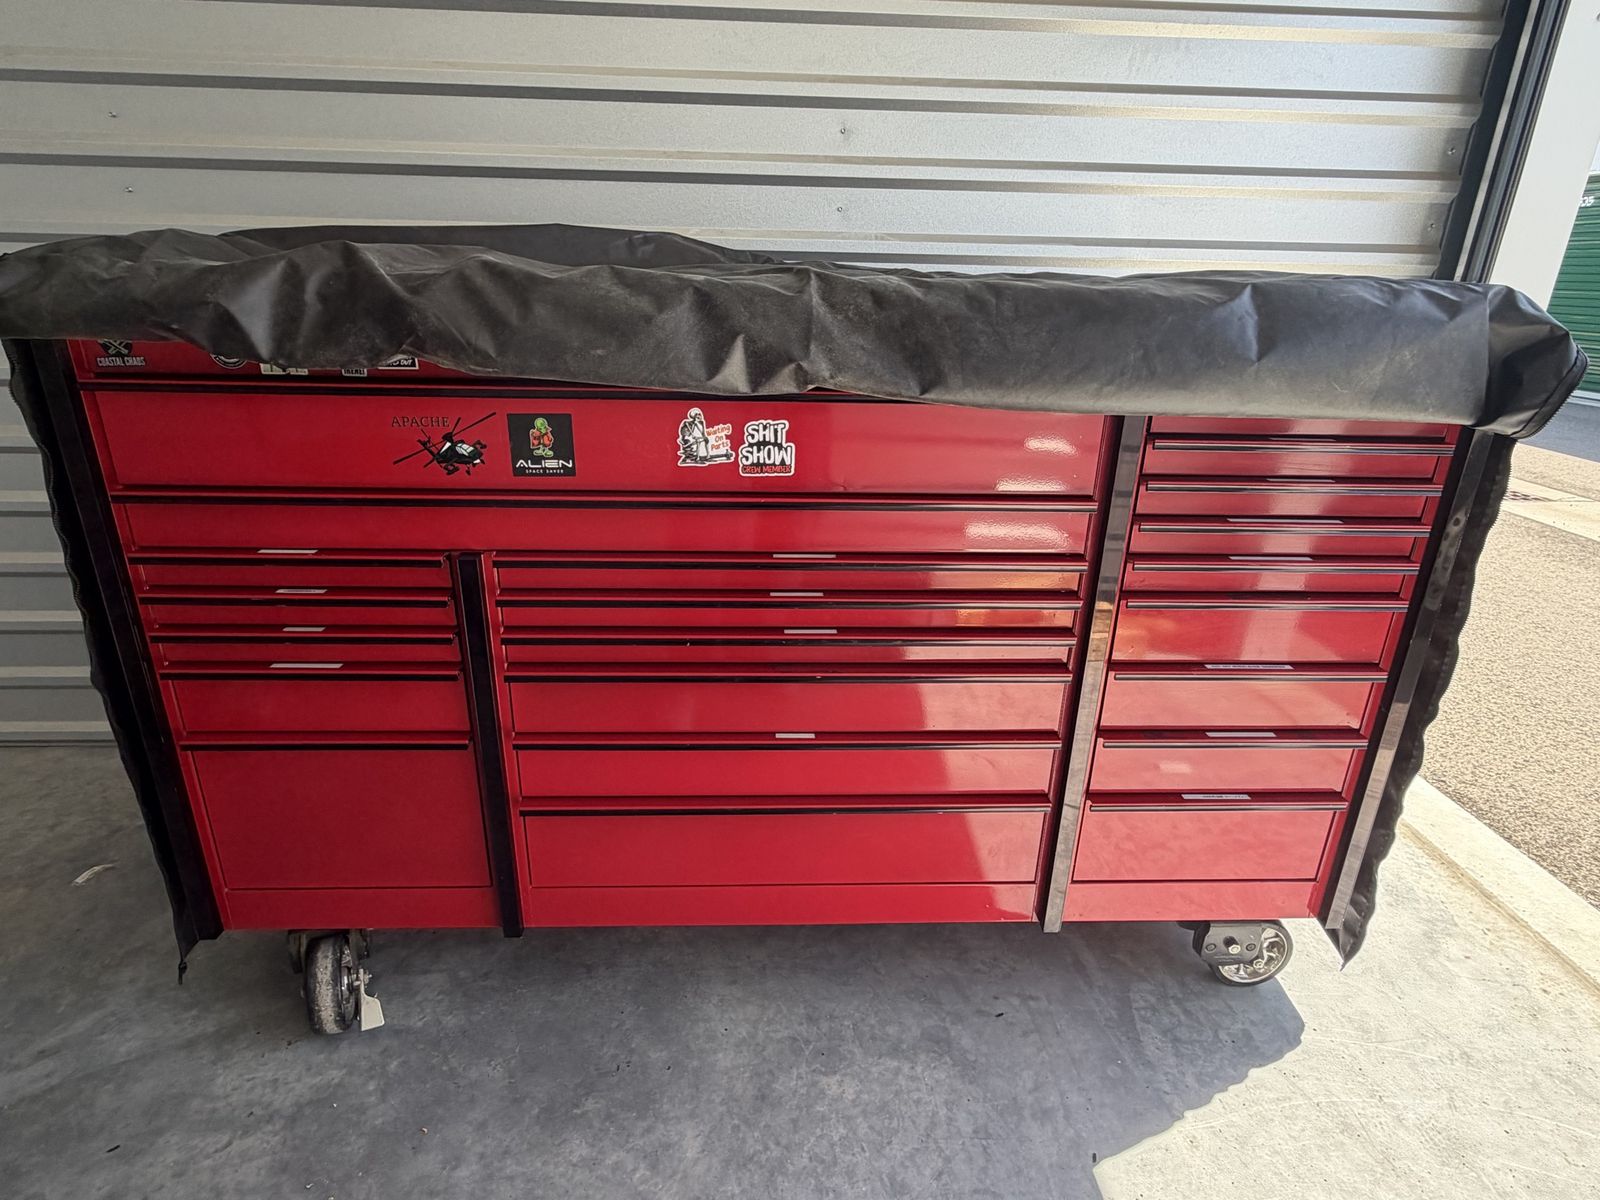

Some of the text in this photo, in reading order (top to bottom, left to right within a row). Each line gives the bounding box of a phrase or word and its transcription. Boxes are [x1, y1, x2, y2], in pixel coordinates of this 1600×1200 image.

[97, 357, 125, 367] COASTAL
[391, 416, 450, 428] APACHE
[706, 424, 731, 437] Waiting
[746, 422, 786, 444] SHIT
[715, 435, 724, 443] On
[711, 440, 729, 451] Parts
[741, 445, 793, 466] SHOW
[515, 459, 573, 468] ALIEN
[742, 465, 791, 473] CREW MEMBER
